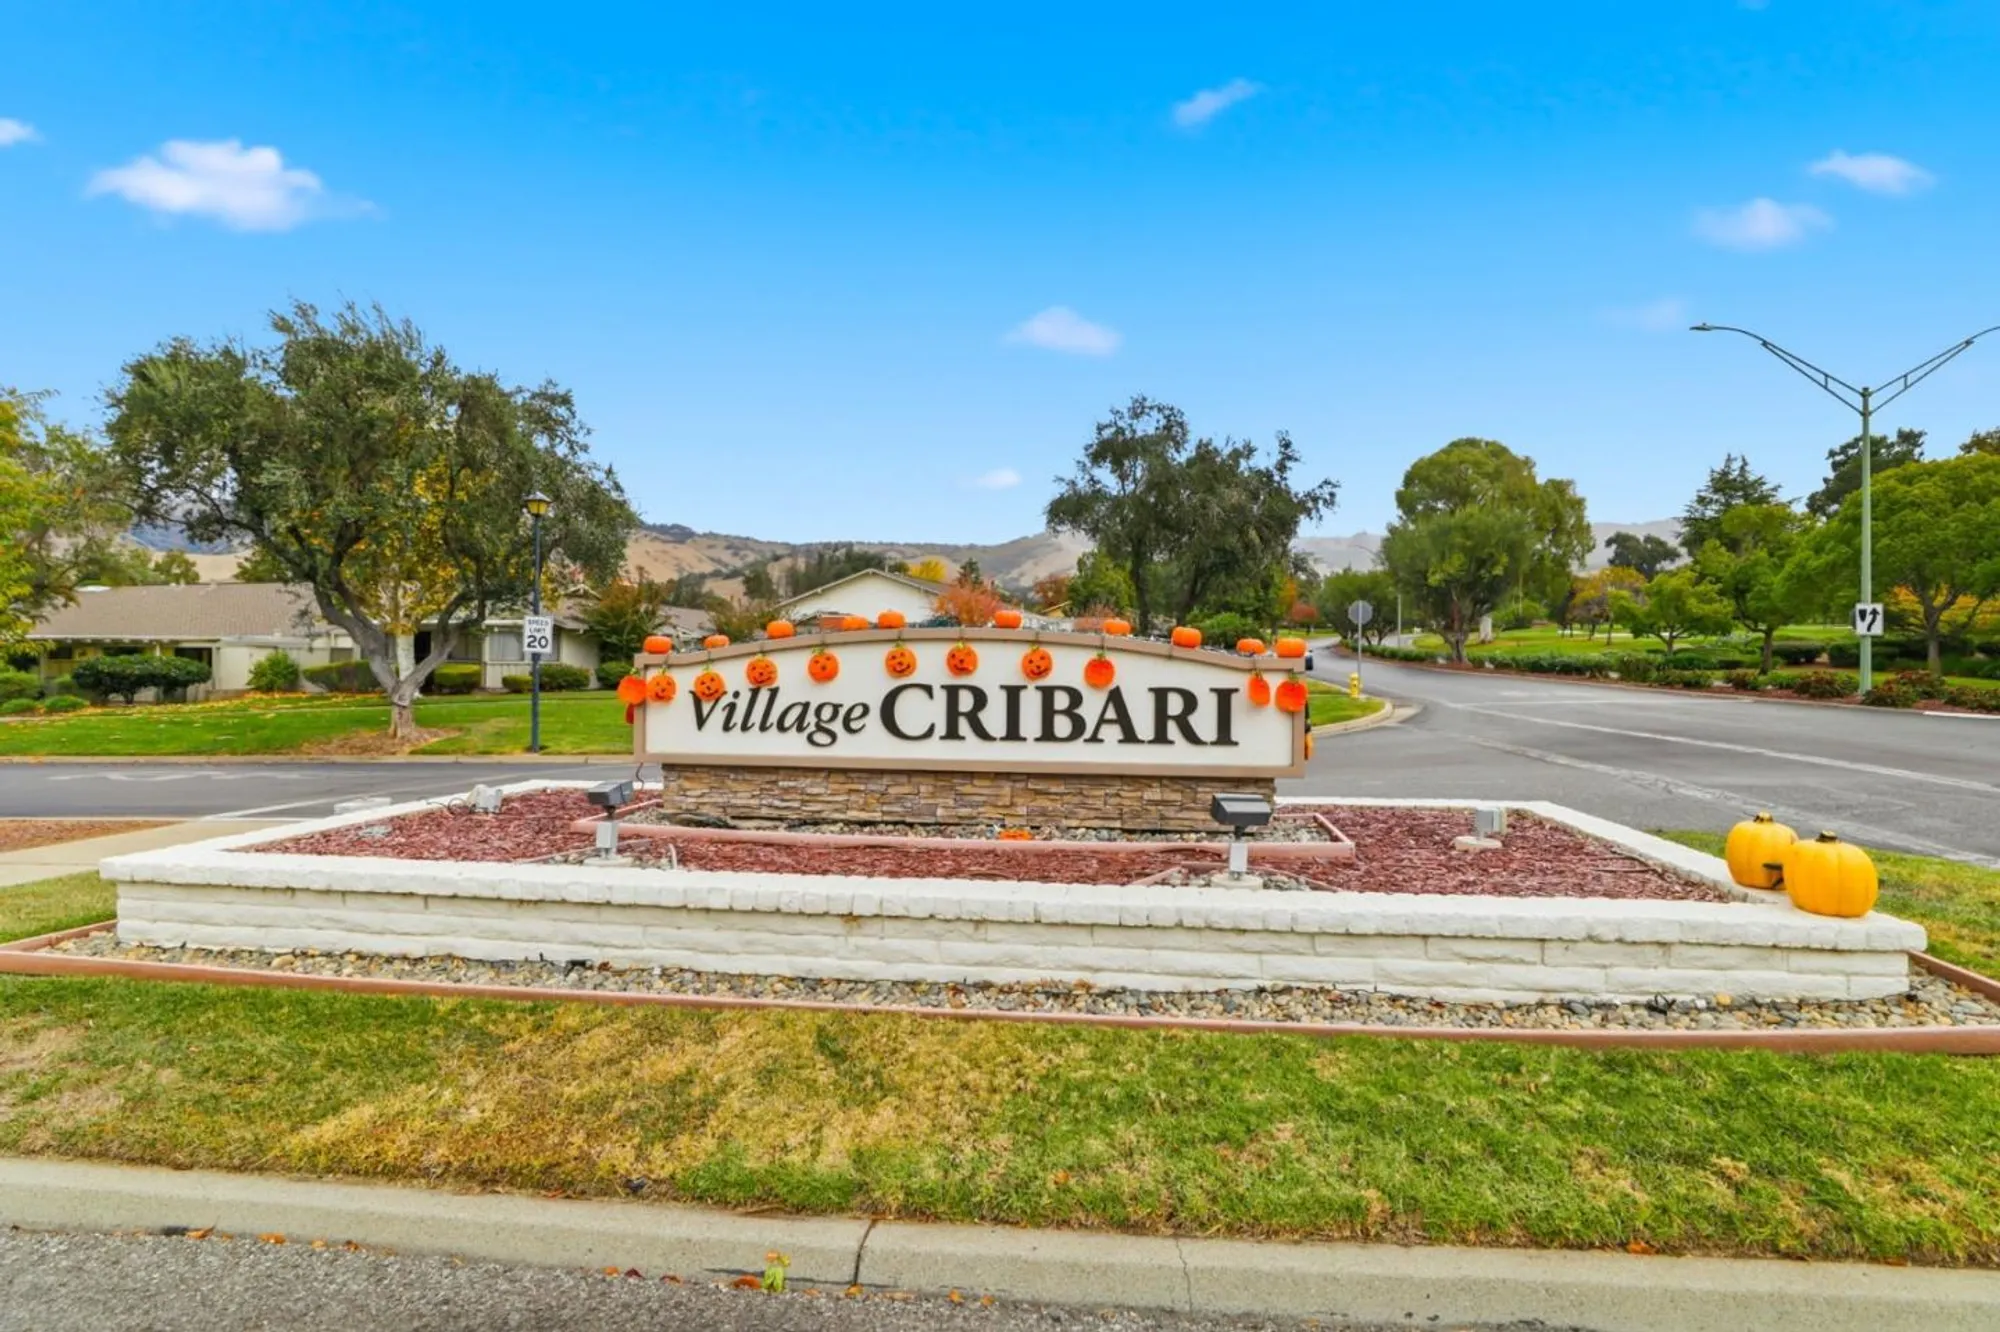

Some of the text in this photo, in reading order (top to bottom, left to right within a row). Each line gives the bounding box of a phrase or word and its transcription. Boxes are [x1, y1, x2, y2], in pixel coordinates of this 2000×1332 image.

[527, 634, 549, 649] 20
[689, 683, 1240, 748] Village CRIBARI
